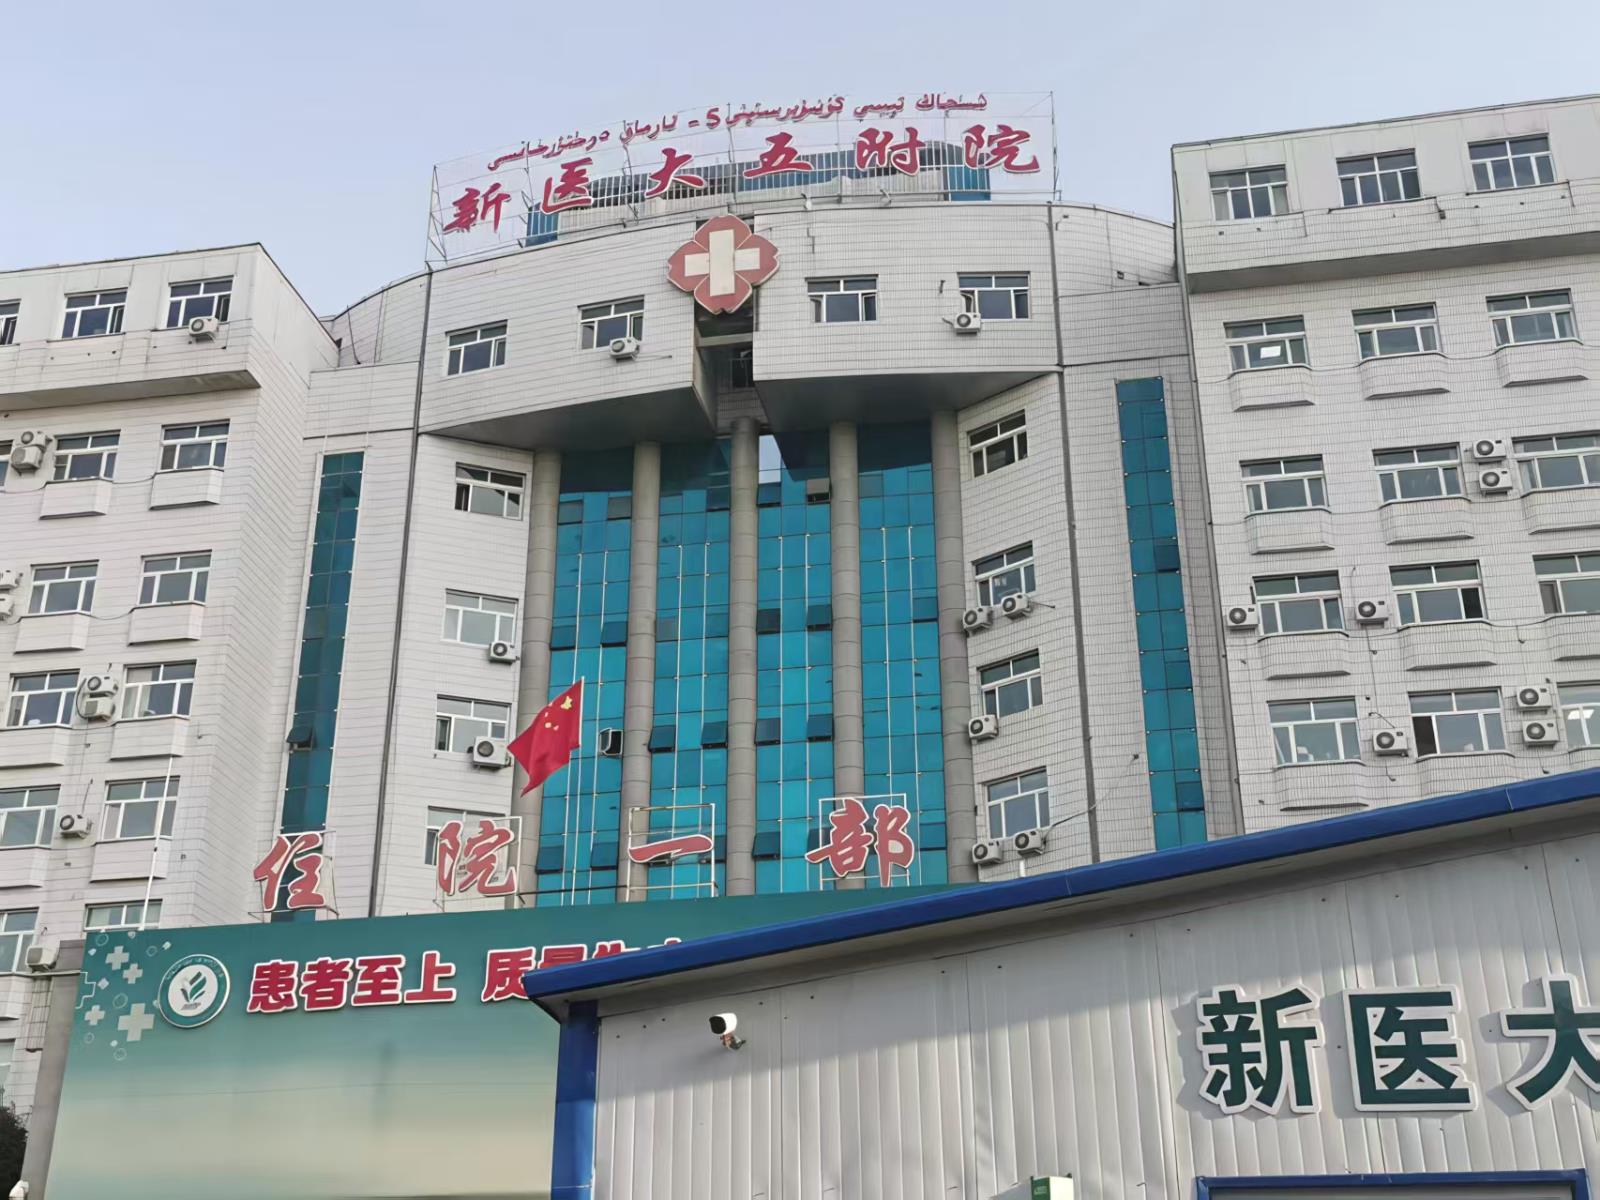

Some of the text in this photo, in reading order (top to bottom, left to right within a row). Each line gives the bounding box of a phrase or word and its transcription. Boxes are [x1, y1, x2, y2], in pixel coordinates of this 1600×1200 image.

[443, 123, 1040, 234] 新医大五附院
[253, 796, 916, 911] 住院一部
[246, 951, 456, 1013] 患者至上
[1200, 974, 1600, 1113] 新医大
